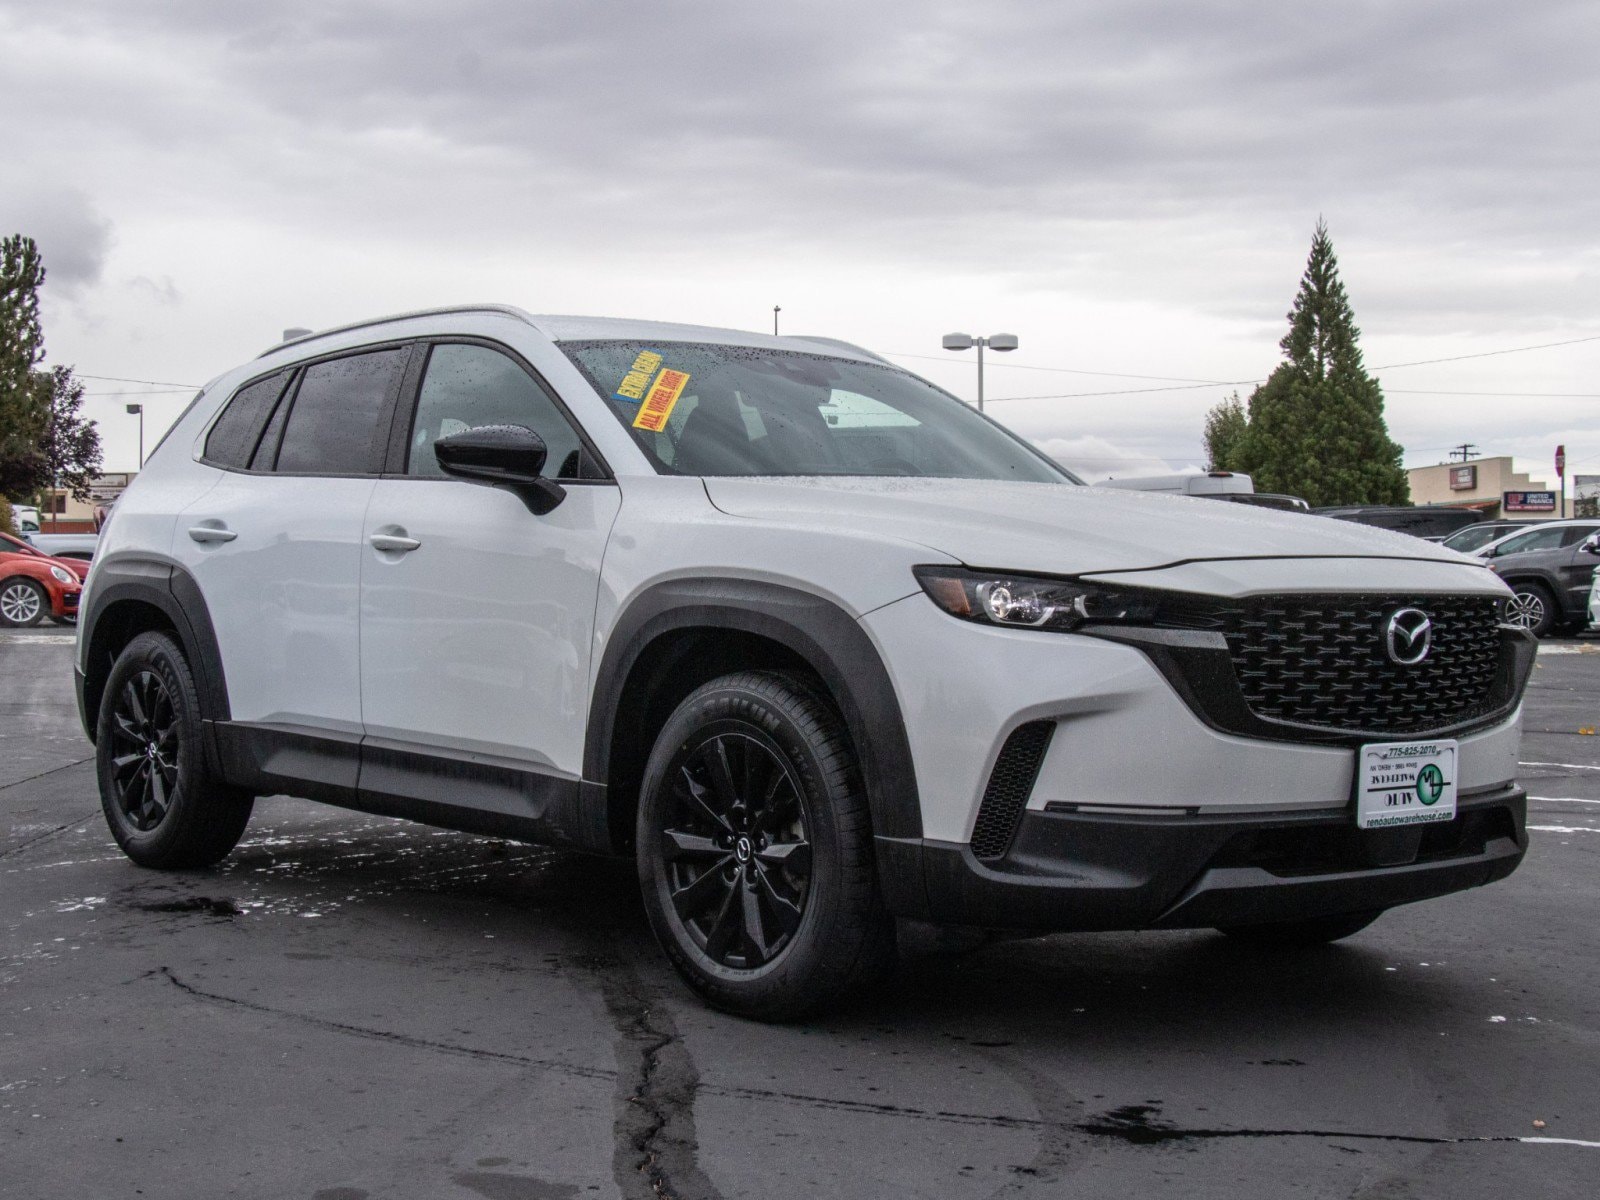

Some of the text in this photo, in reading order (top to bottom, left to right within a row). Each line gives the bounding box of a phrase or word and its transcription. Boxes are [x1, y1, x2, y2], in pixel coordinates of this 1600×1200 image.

[617, 350, 664, 399] EXTRA CLEAN
[639, 371, 683, 430] ALL WHEEL DRIVE
[1389, 745, 1437, 757] 775-825-2070
[1384, 792, 1414, 807] AUTO
[1366, 812, 1453, 827] renoautowarehouse.com
